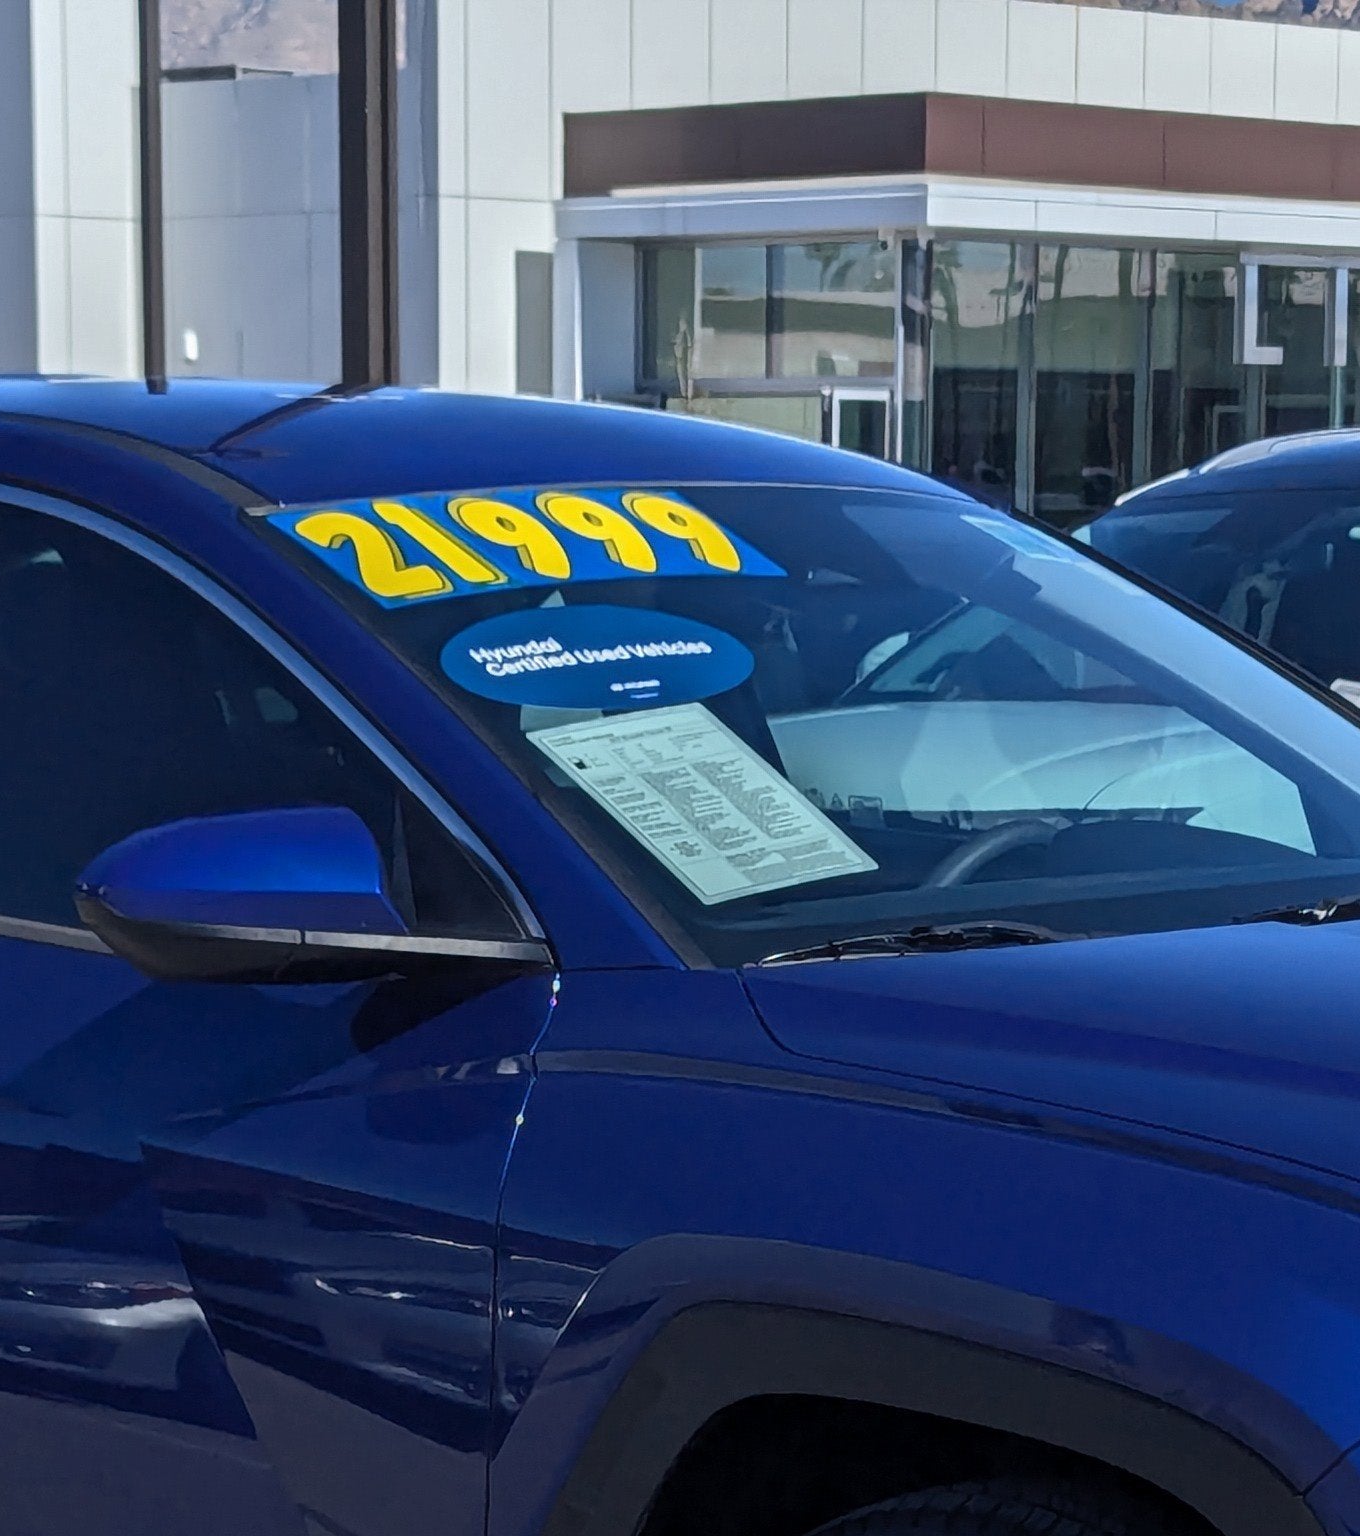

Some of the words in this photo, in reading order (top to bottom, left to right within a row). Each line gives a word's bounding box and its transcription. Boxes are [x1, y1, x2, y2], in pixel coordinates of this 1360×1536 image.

[295, 492, 741, 597] 21999
[469, 636, 562, 664] Hyundai
[486, 650, 579, 678] Certified
[574, 644, 631, 664] Used
[627, 641, 713, 659] Vehicles
